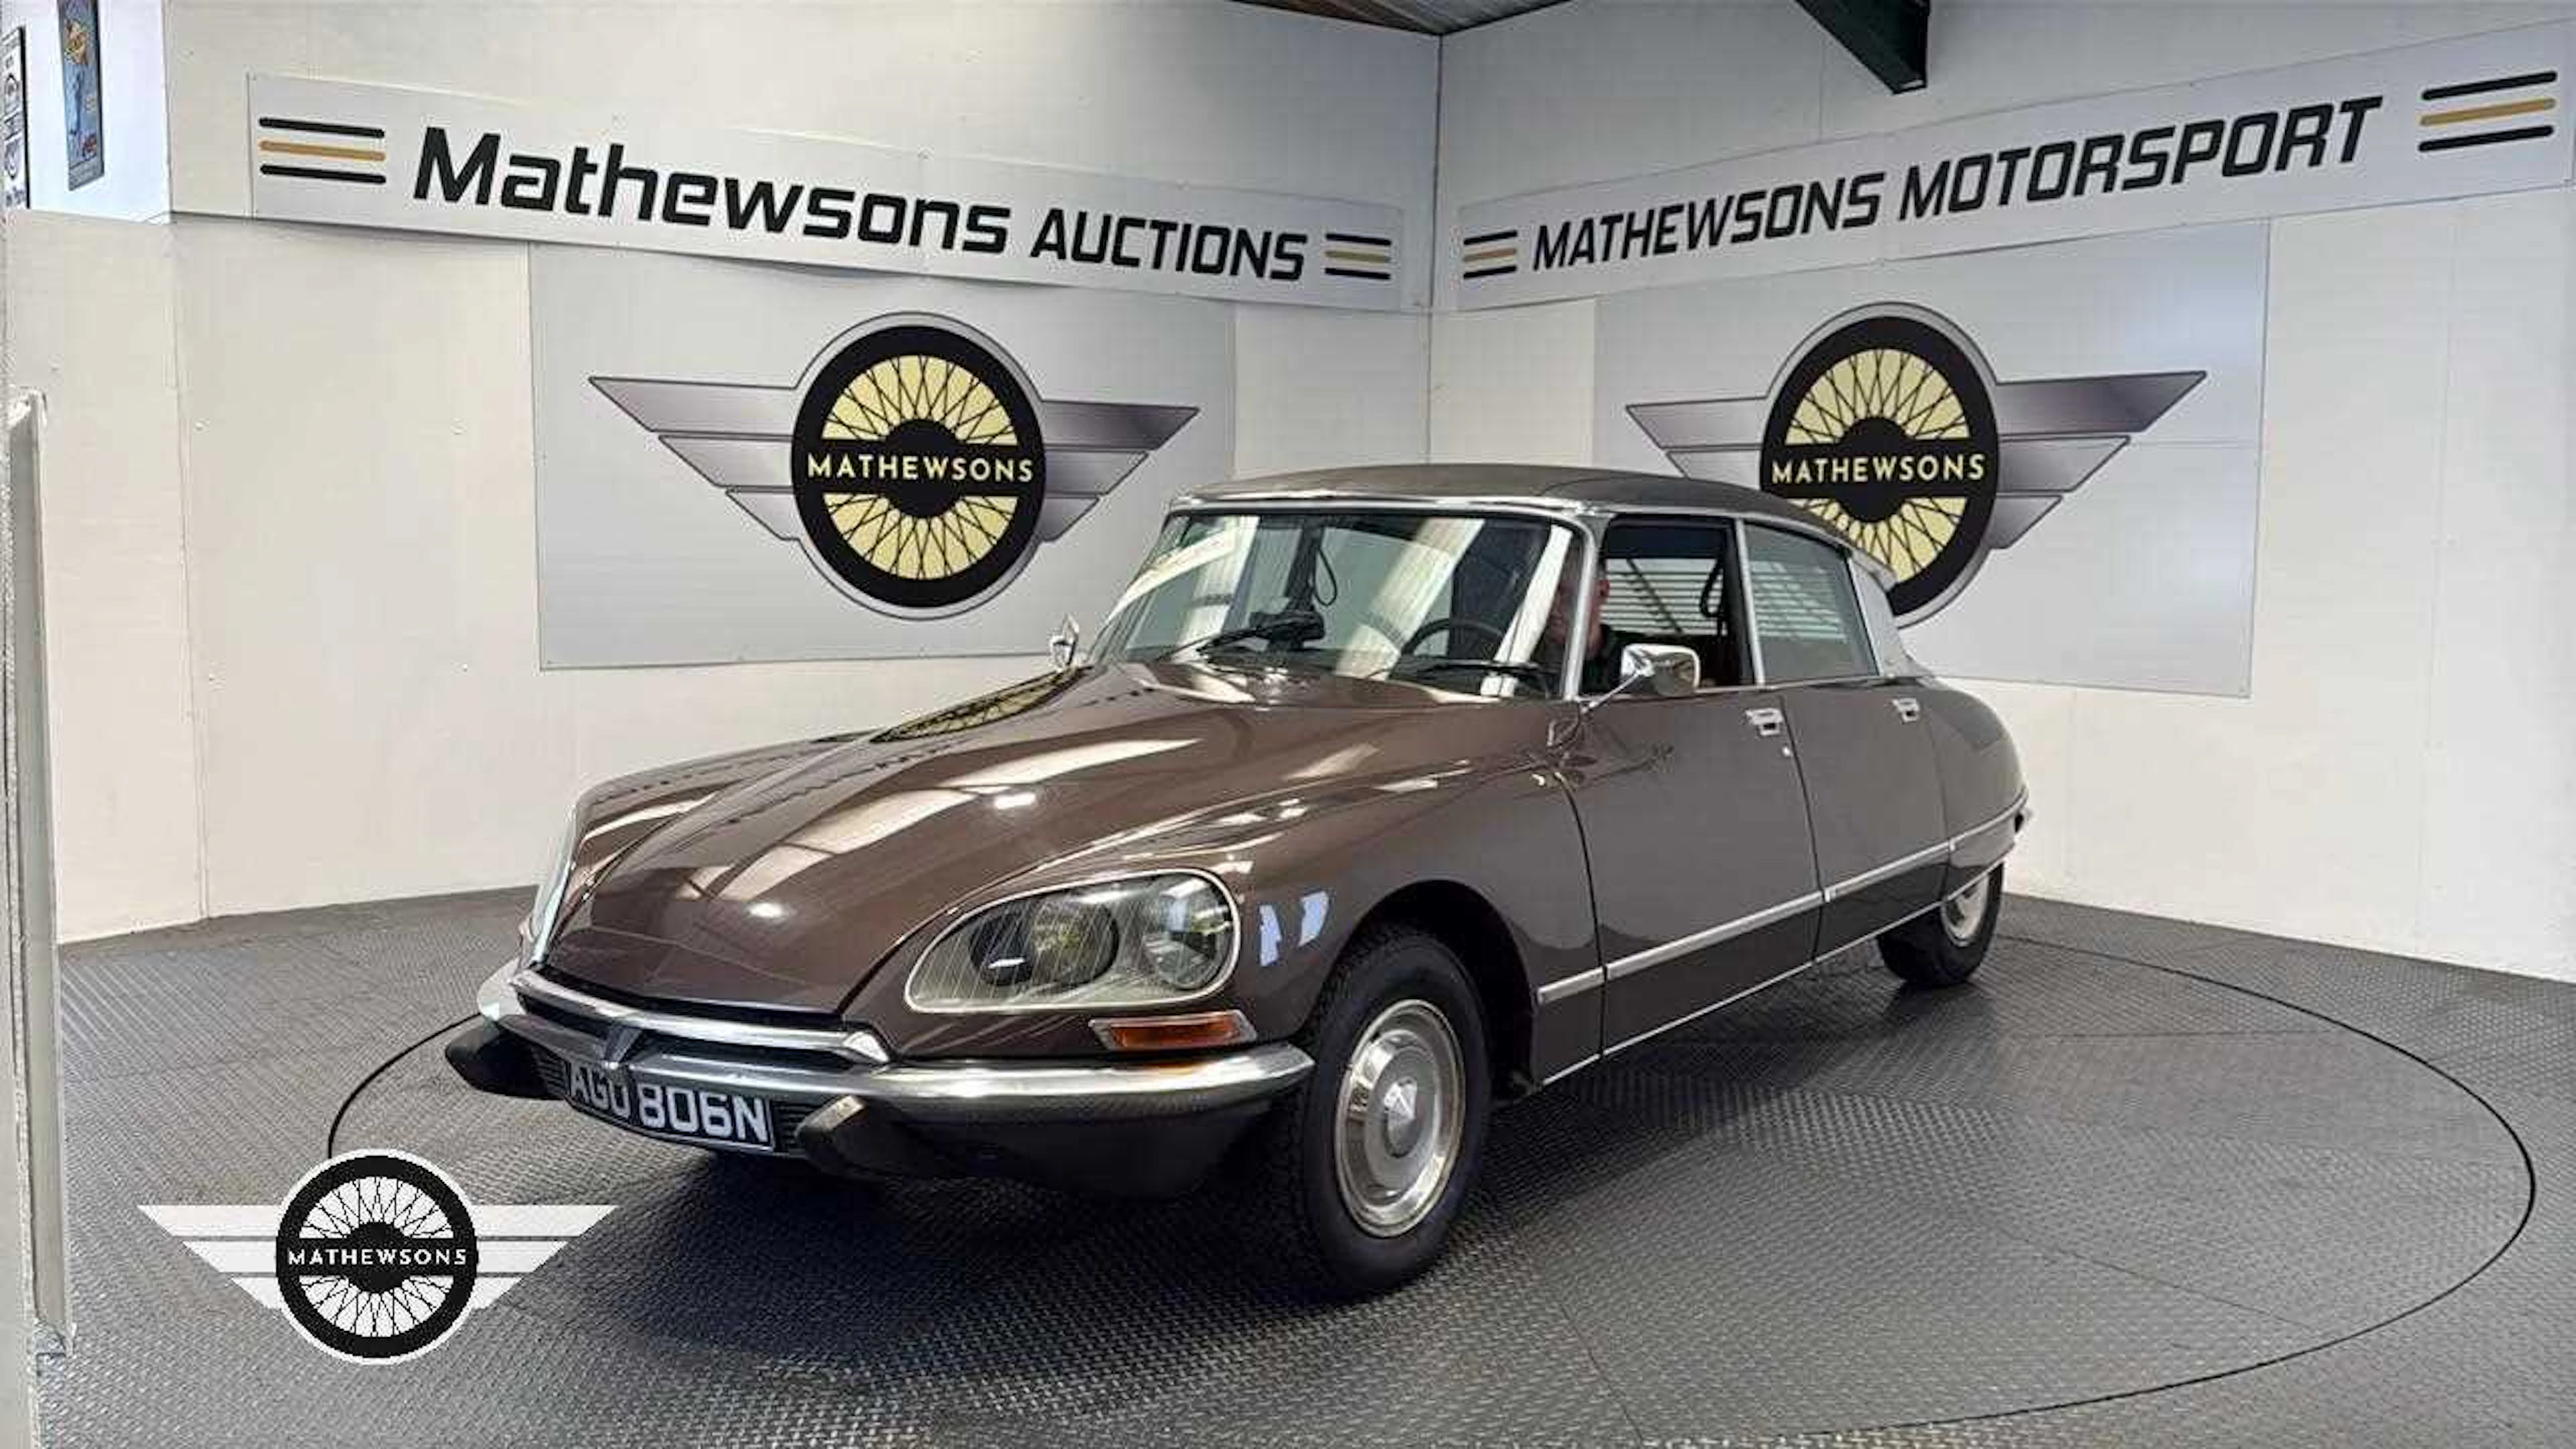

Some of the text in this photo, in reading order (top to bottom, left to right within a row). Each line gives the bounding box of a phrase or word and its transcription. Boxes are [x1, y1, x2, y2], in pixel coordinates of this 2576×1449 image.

[413, 126, 1308, 280] Mathewsons AUCTIONS
[1533, 95, 2383, 271] MATHEWSONS MOTORSPORT
[808, 453, 1033, 482] MATHEWSONS
[1772, 453, 1985, 484] MATHEWSONS
[637, 1083, 769, 1143] 806N
